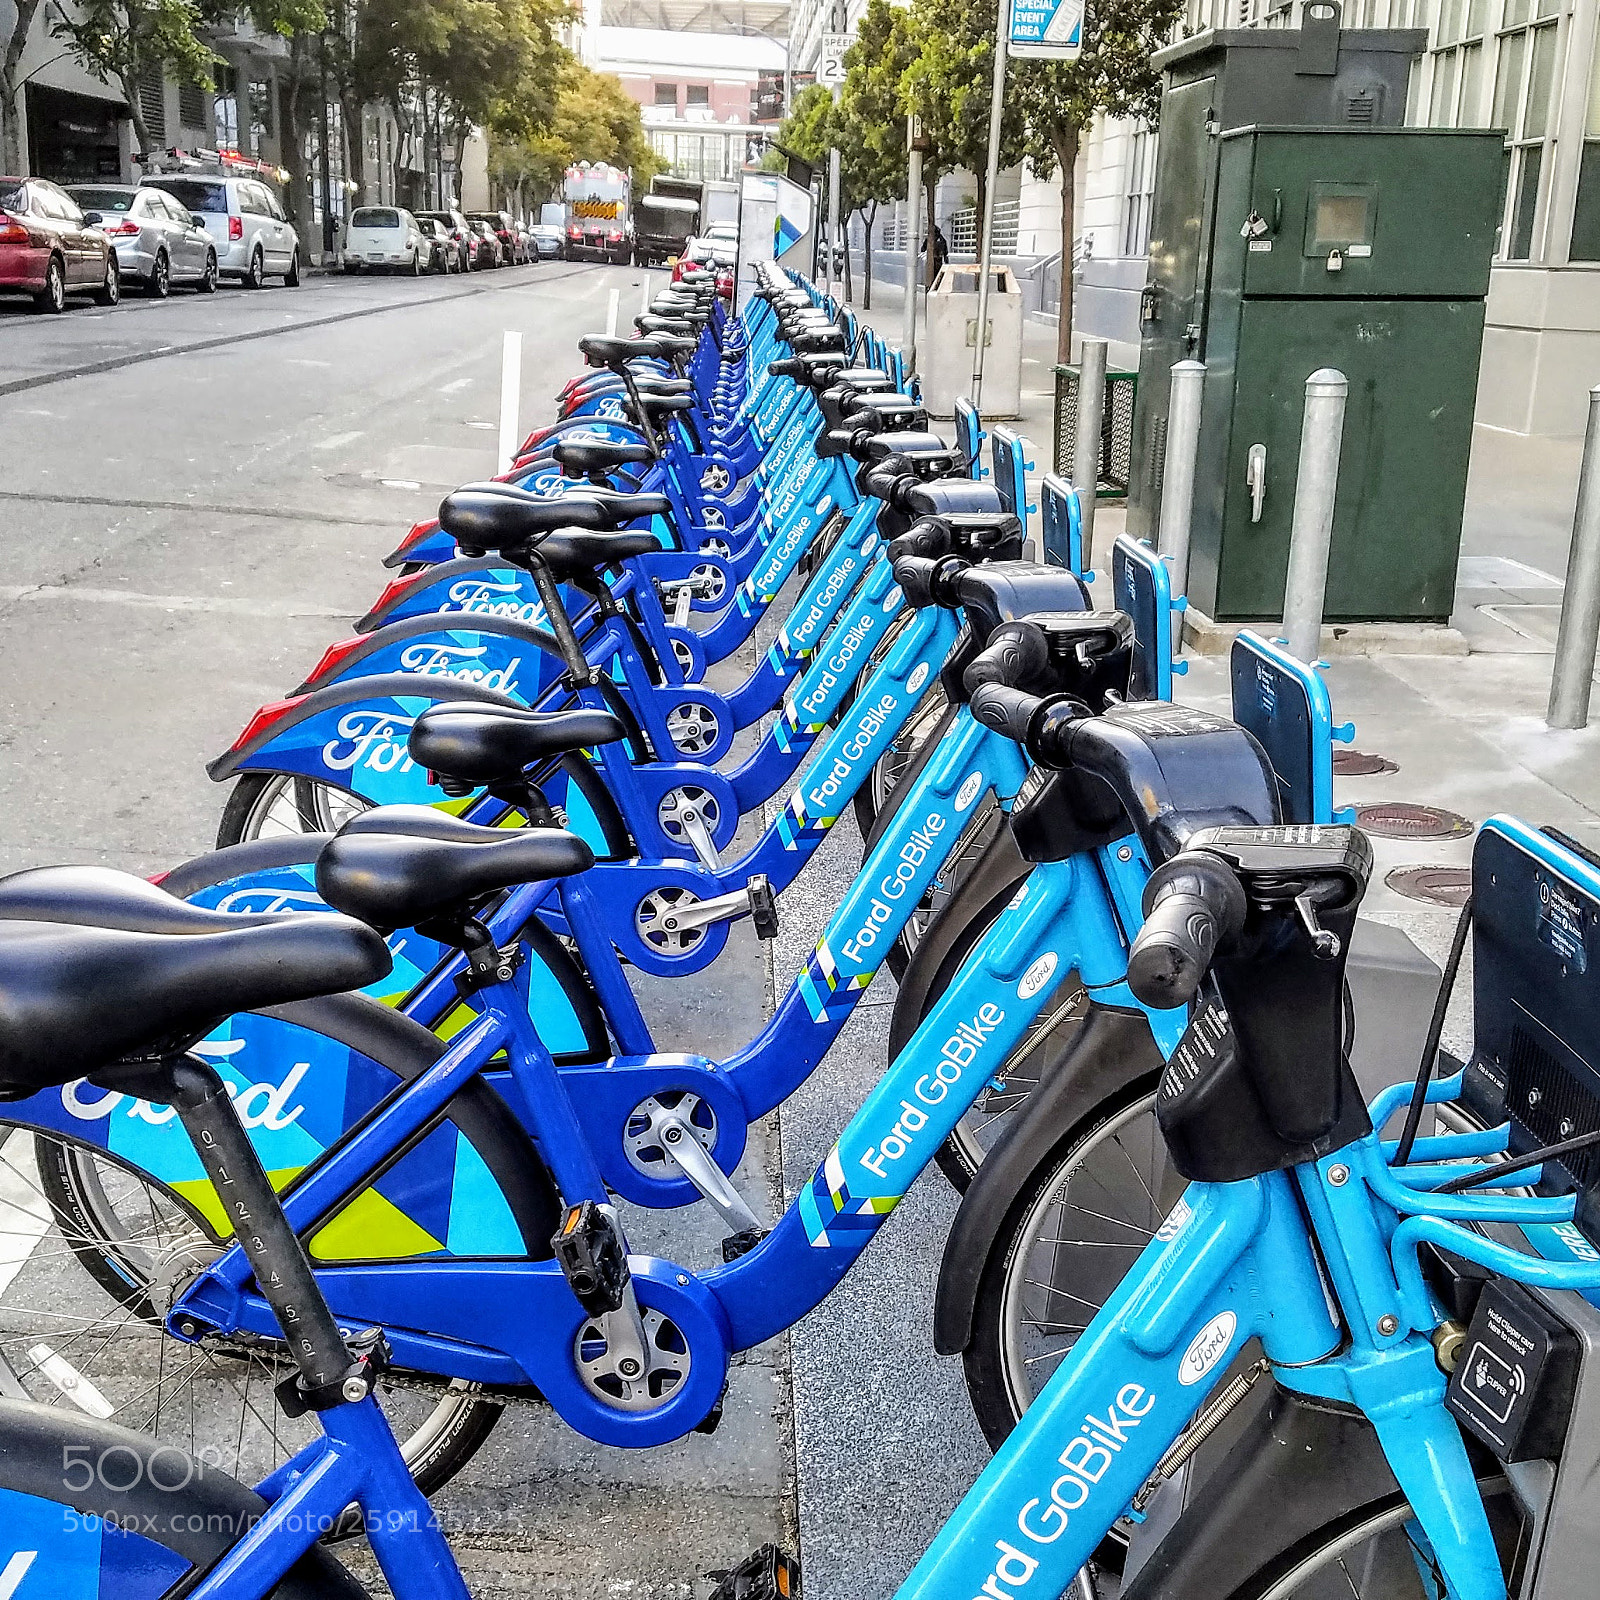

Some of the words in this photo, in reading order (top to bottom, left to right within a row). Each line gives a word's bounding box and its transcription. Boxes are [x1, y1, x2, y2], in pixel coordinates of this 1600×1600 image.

[1015, 0, 1055, 10] SPECIAL
[1015, 12, 1046, 23] EVENT
[824, 38, 855, 47] SPEED
[1013, 25, 1040, 36] AREA
[768, 449, 785, 472] Ford
[782, 420, 803, 450] GoBike
[774, 492, 795, 519] Ford
[790, 456, 817, 493] GoBike
[757, 558, 783, 590] Ford
[777, 516, 811, 560] GoBike
[793, 605, 823, 642] Ford
[817, 557, 856, 607] GoBike
[802, 670, 837, 714] Ford
[829, 615, 874, 672] GoBike
[809, 757, 852, 808] Ford
[842, 694, 898, 761] GoBike
[841, 898, 893, 964] Ford
[881, 813, 946, 900] GoBike
[1025, 962, 1051, 991] Ford
[859, 1100, 930, 1178] Ford
[914, 1003, 1005, 1105] GoBike
[201, 1130, 213, 1144] 0
[218, 1167, 229, 1179] 1
[235, 1201, 248, 1215] 2
[252, 1236, 264, 1250] 3
[270, 1270, 280, 1284] 4
[285, 1305, 296, 1318] 5
[1487, 1308, 1502, 1324] Hold
[1501, 1319, 1521, 1340] Clipper
[1520, 1336, 1535, 1350] card
[1487, 1320, 1501, 1335] here
[1501, 1331, 1507, 1340] to
[1506, 1337, 1527, 1356] unlock
[301, 1338, 312, 1352] 6
[1189, 1325, 1227, 1373] Ford
[315, 1372, 325, 1384] 7
[1486, 1375, 1507, 1397] CLIPPER
[428, 1437, 451, 1465] PLUS
[1018, 1383, 1156, 1545] GoBike
